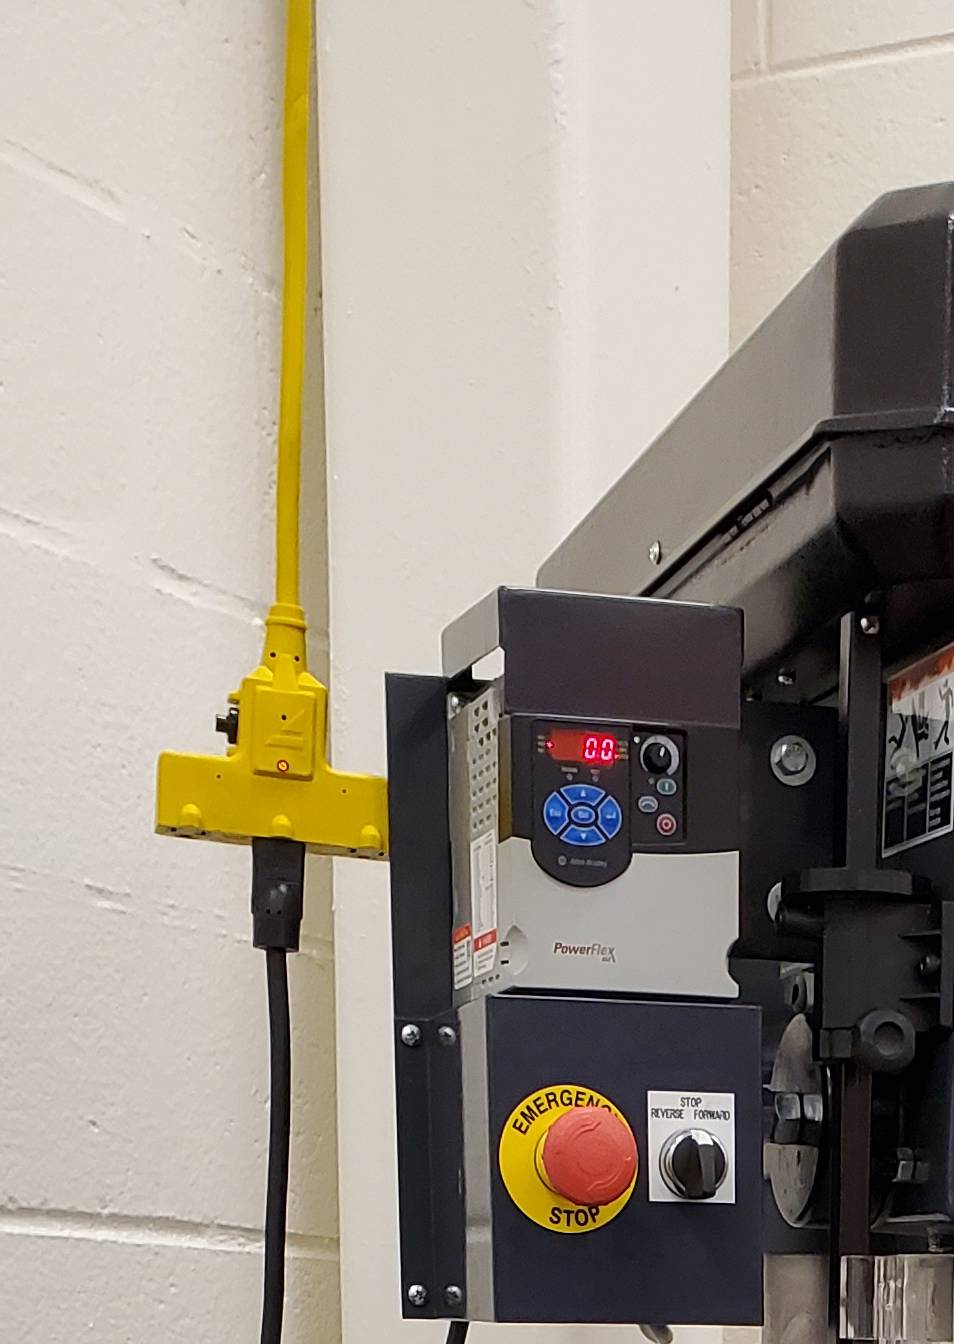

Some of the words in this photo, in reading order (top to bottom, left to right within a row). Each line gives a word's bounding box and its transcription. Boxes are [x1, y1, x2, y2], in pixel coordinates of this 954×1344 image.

[553, 942, 615, 963] PowerFlex
[512, 1089, 618, 1136] EMERGEN
[680, 1097, 702, 1108] STOP
[651, 1108, 685, 1119] REVERSE
[694, 1109, 731, 1121] FORWARD
[549, 1206, 600, 1227] STOP
